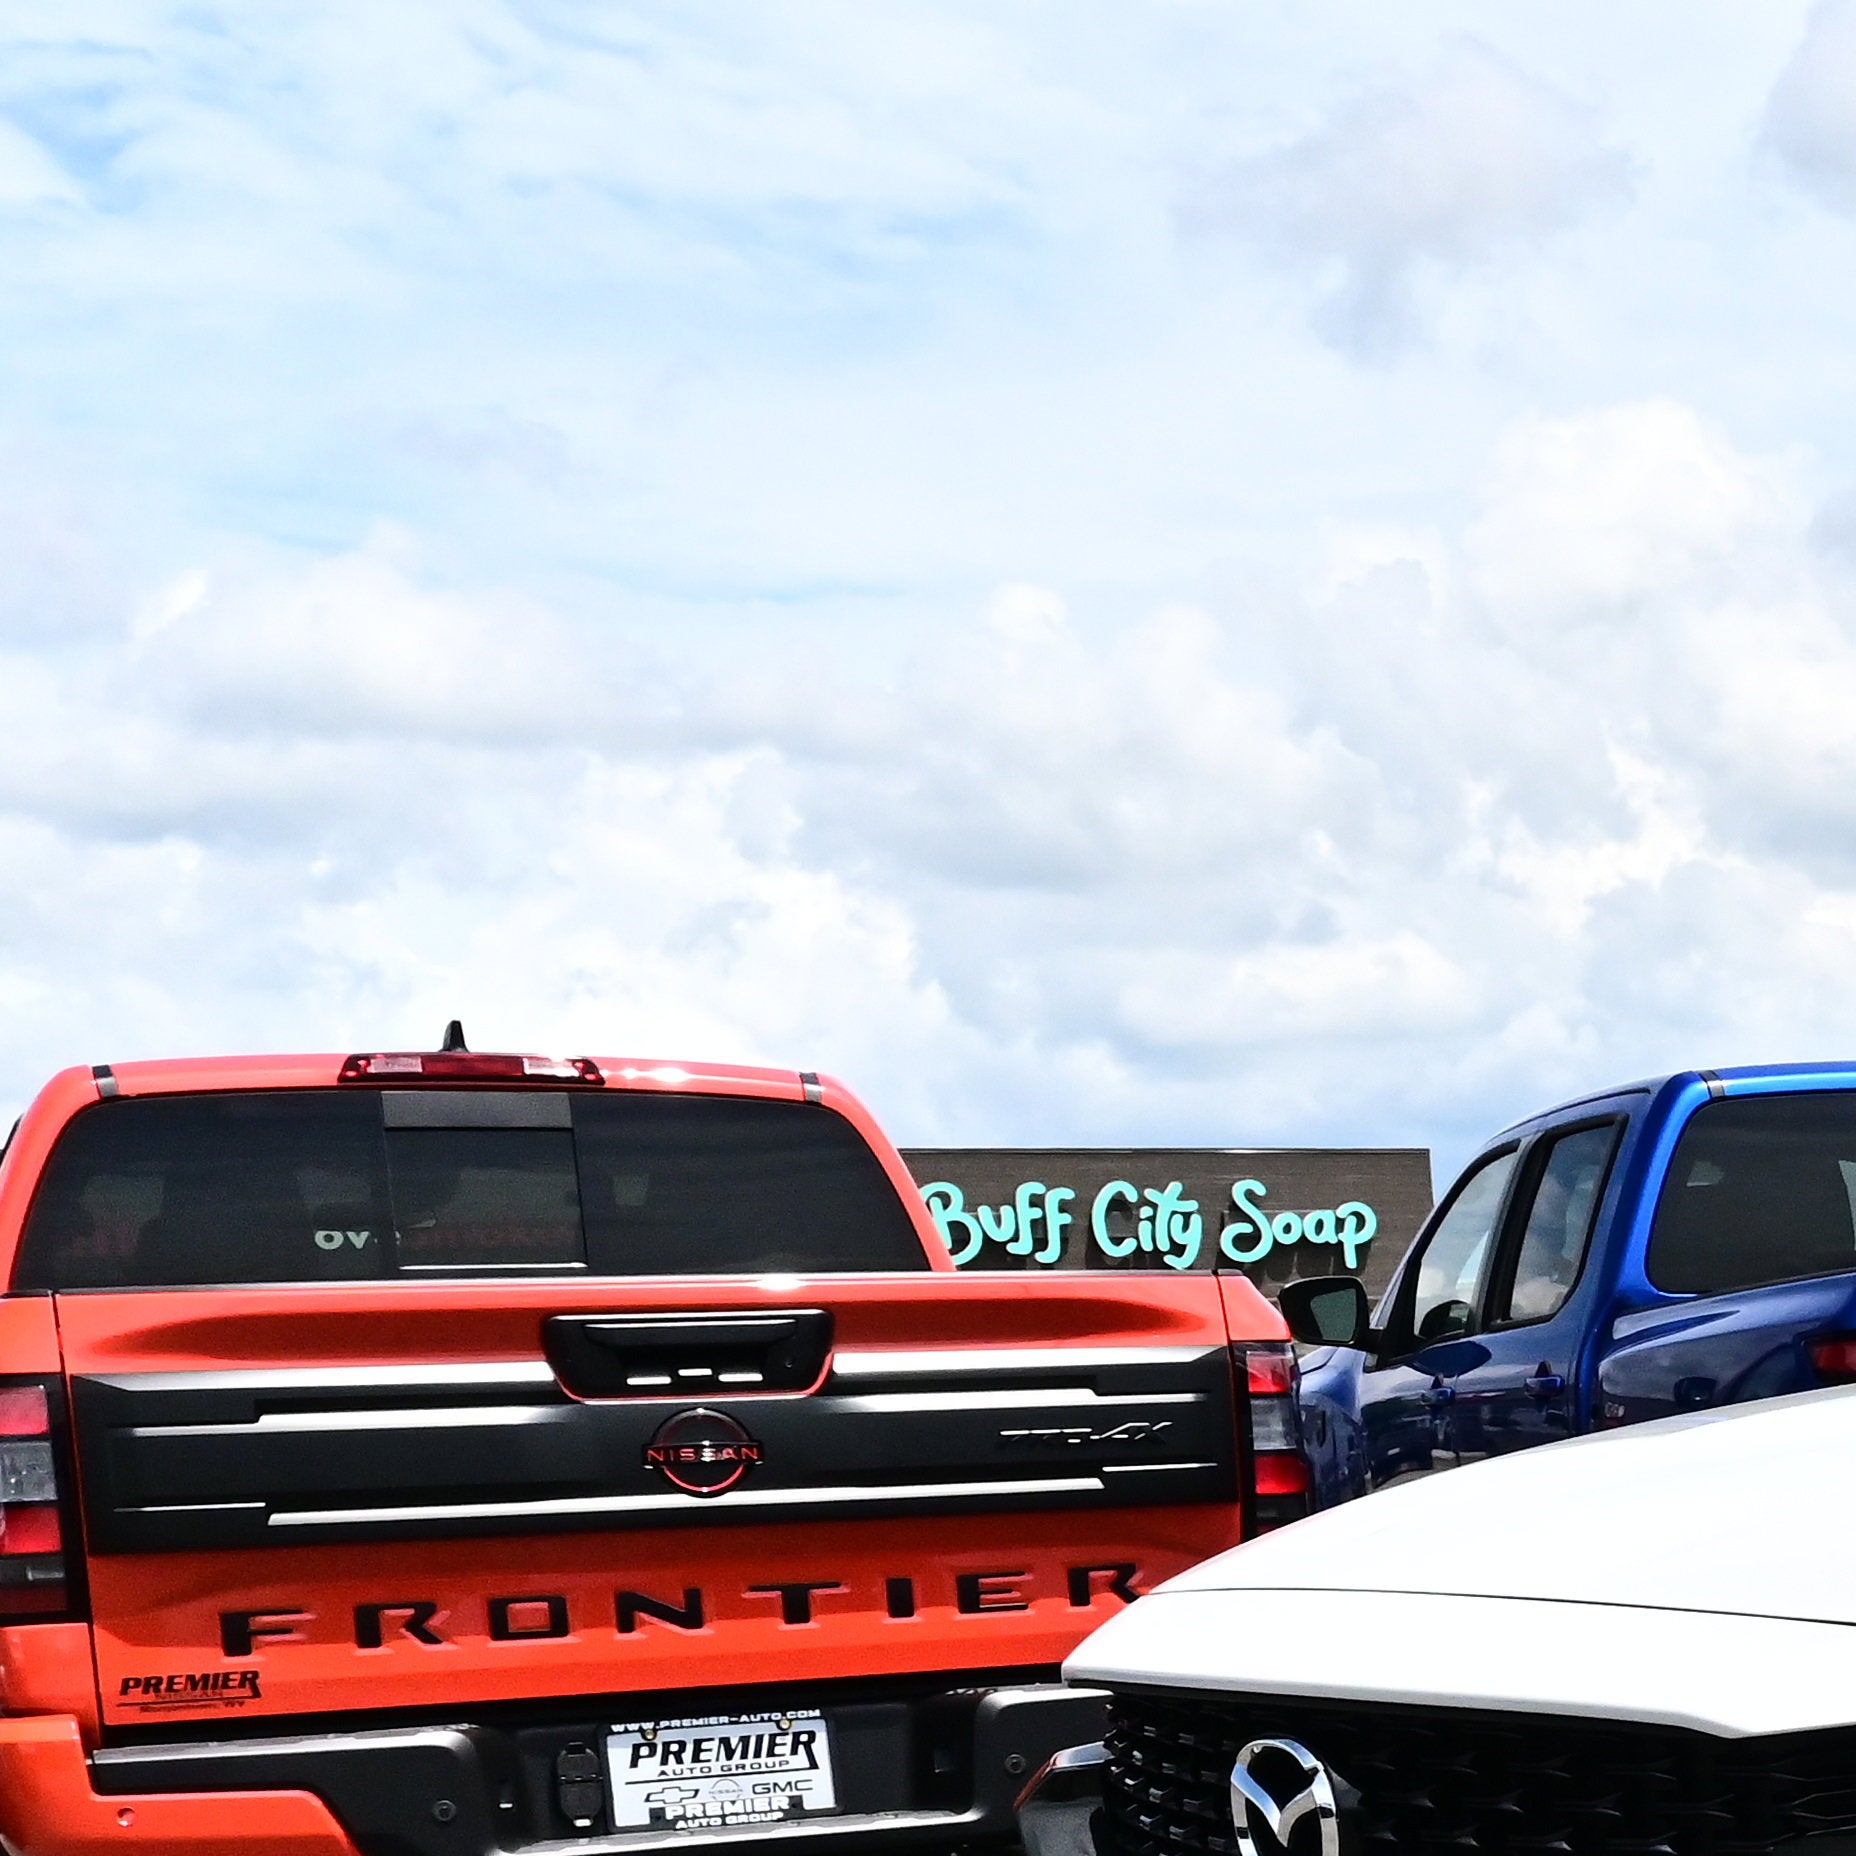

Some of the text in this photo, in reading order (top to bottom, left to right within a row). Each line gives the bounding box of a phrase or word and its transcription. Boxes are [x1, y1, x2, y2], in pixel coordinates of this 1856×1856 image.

[919, 1179, 1377, 1270] Buff City Soap
[219, 1562, 1143, 1657] FRONTIER
[119, 1670, 262, 1699] PREMIER
[611, 1709, 821, 1733] WWW.PREMIER-AUTO.COM
[629, 1730, 820, 1769] PREMIER
[657, 1760, 790, 1777] AUTO GROUP
[752, 1779, 814, 1796] GMC
[665, 1796, 790, 1820] PREMIER
[675, 1810, 784, 1830] AUTO GROUP
